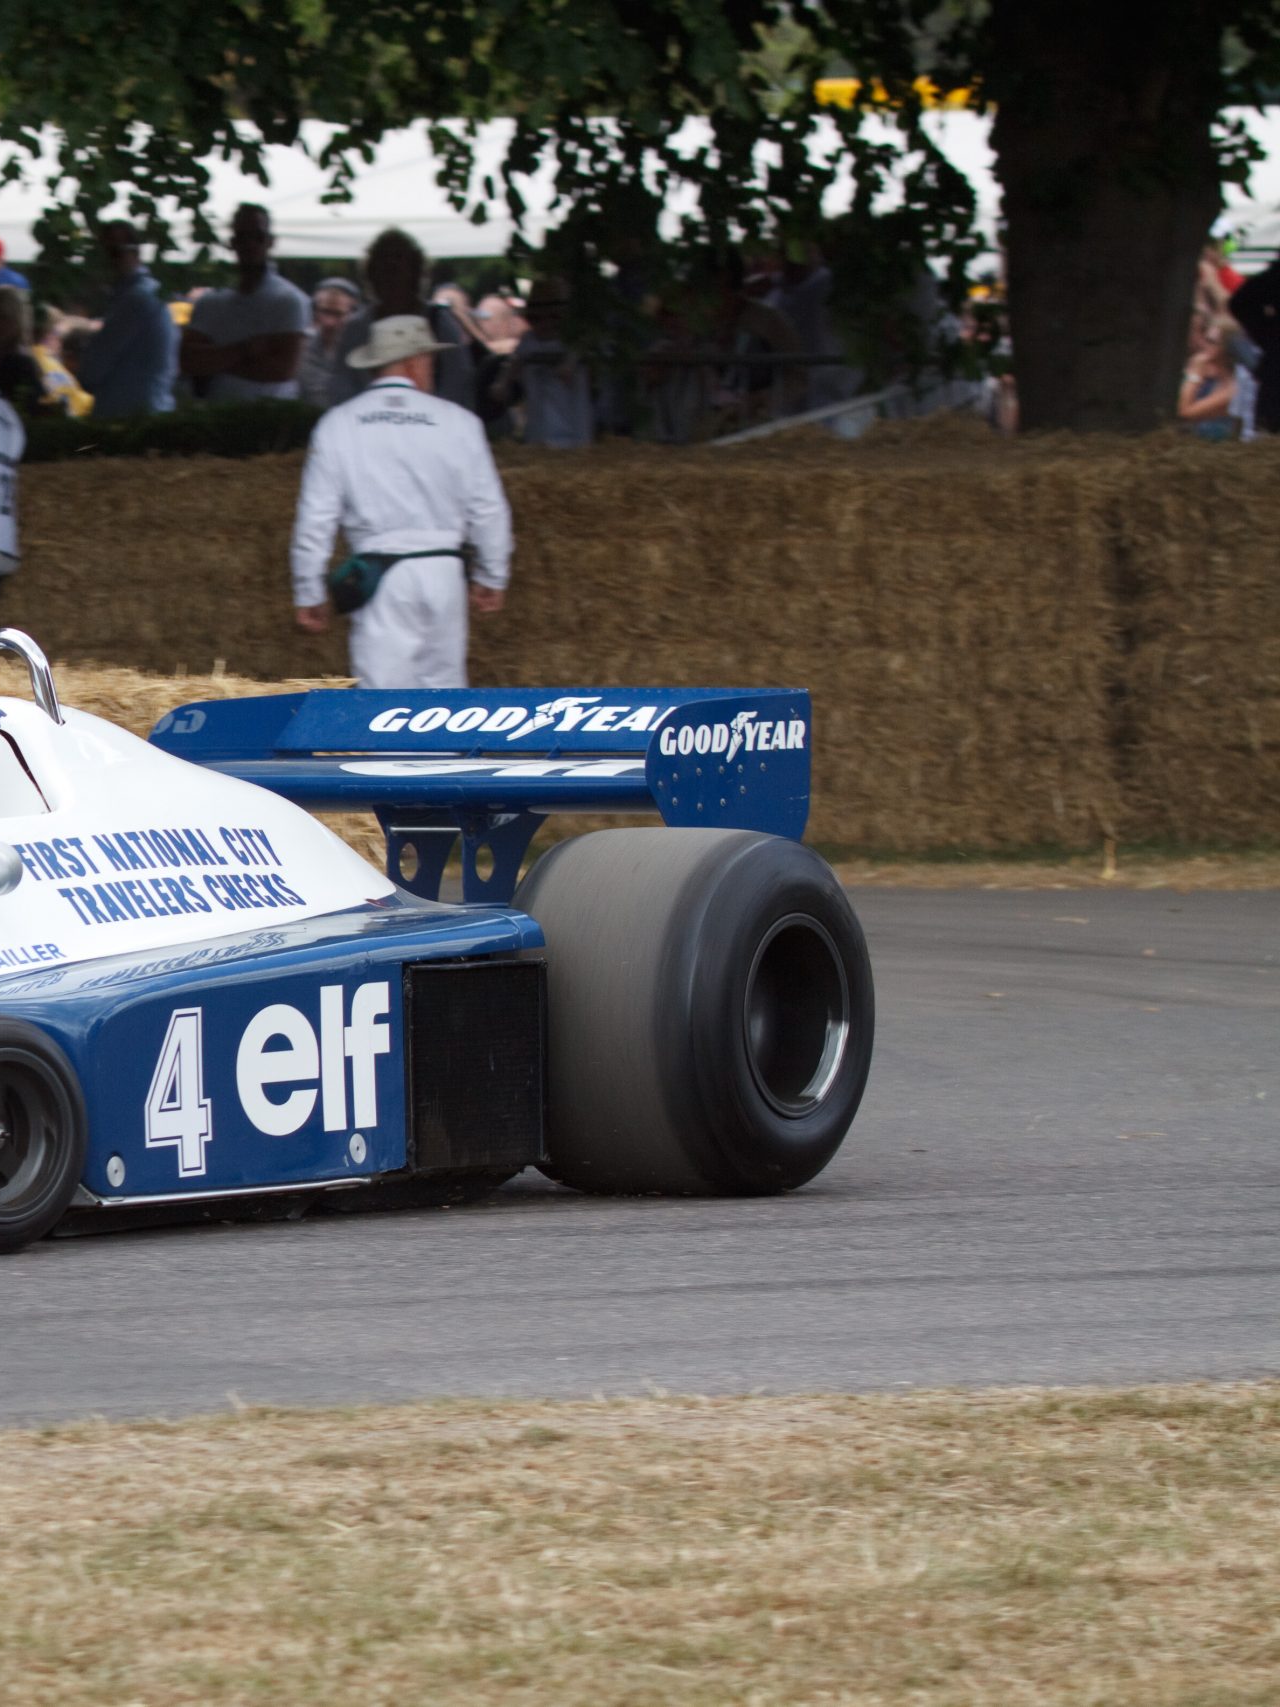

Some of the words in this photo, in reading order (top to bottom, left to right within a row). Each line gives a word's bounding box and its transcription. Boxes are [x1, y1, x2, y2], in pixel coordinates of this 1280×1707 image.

[12, 837, 101, 881] FIRST
[91, 828, 228, 871] NATIONAL
[218, 826, 283, 866] CITY
[57, 875, 212, 925] TRAVELERS
[203, 873, 307, 911] CHECKS
[144, 1006, 213, 1178] 4
[236, 981, 391, 1137] elf
